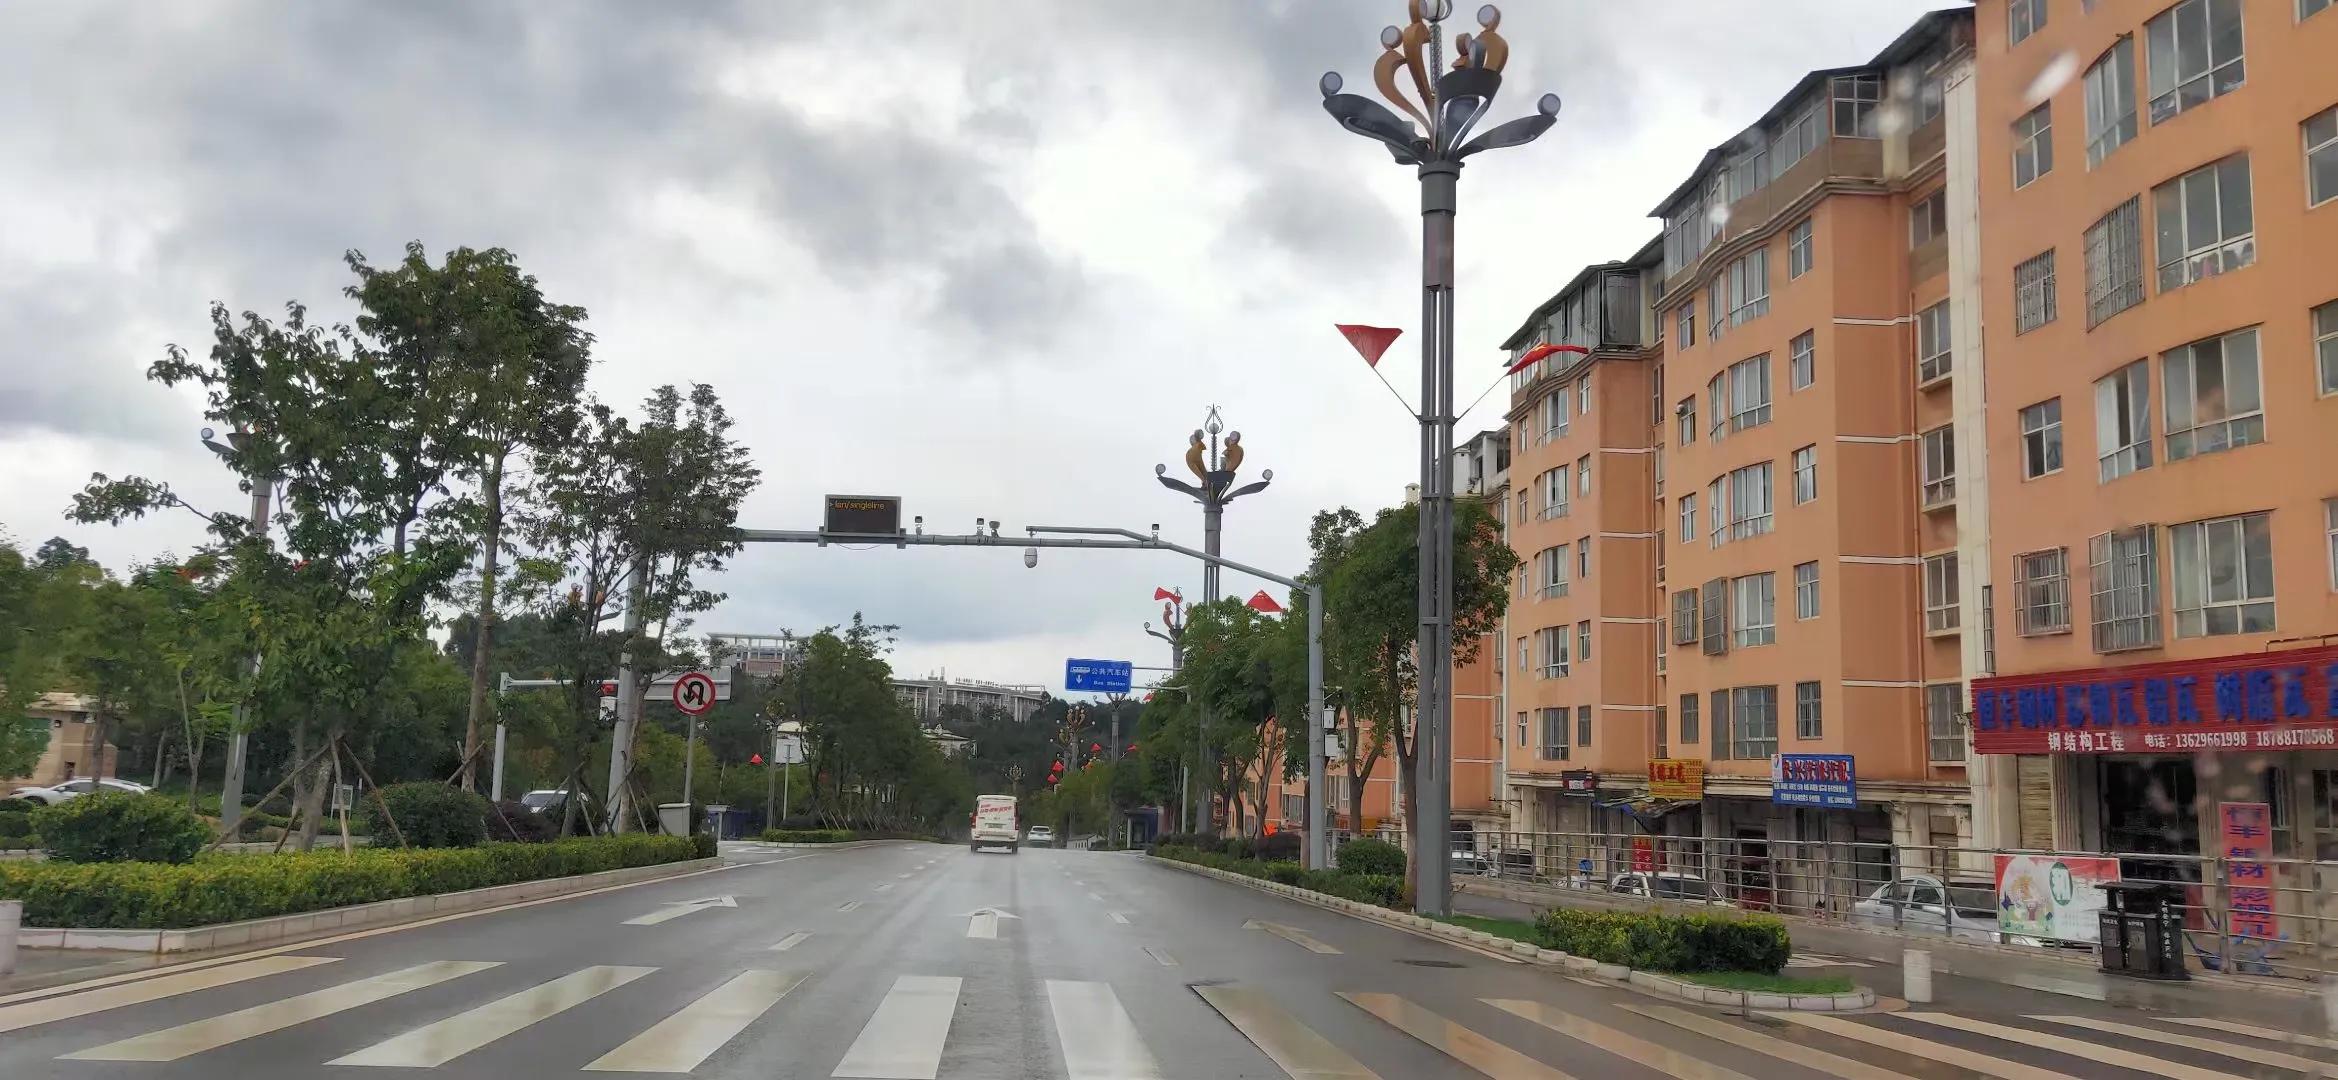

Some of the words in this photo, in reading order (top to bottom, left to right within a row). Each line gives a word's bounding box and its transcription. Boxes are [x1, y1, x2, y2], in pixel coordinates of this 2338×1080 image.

[1091, 667, 1128, 677] 公共汽车站
[2047, 731, 2126, 752] 钢结构工程
